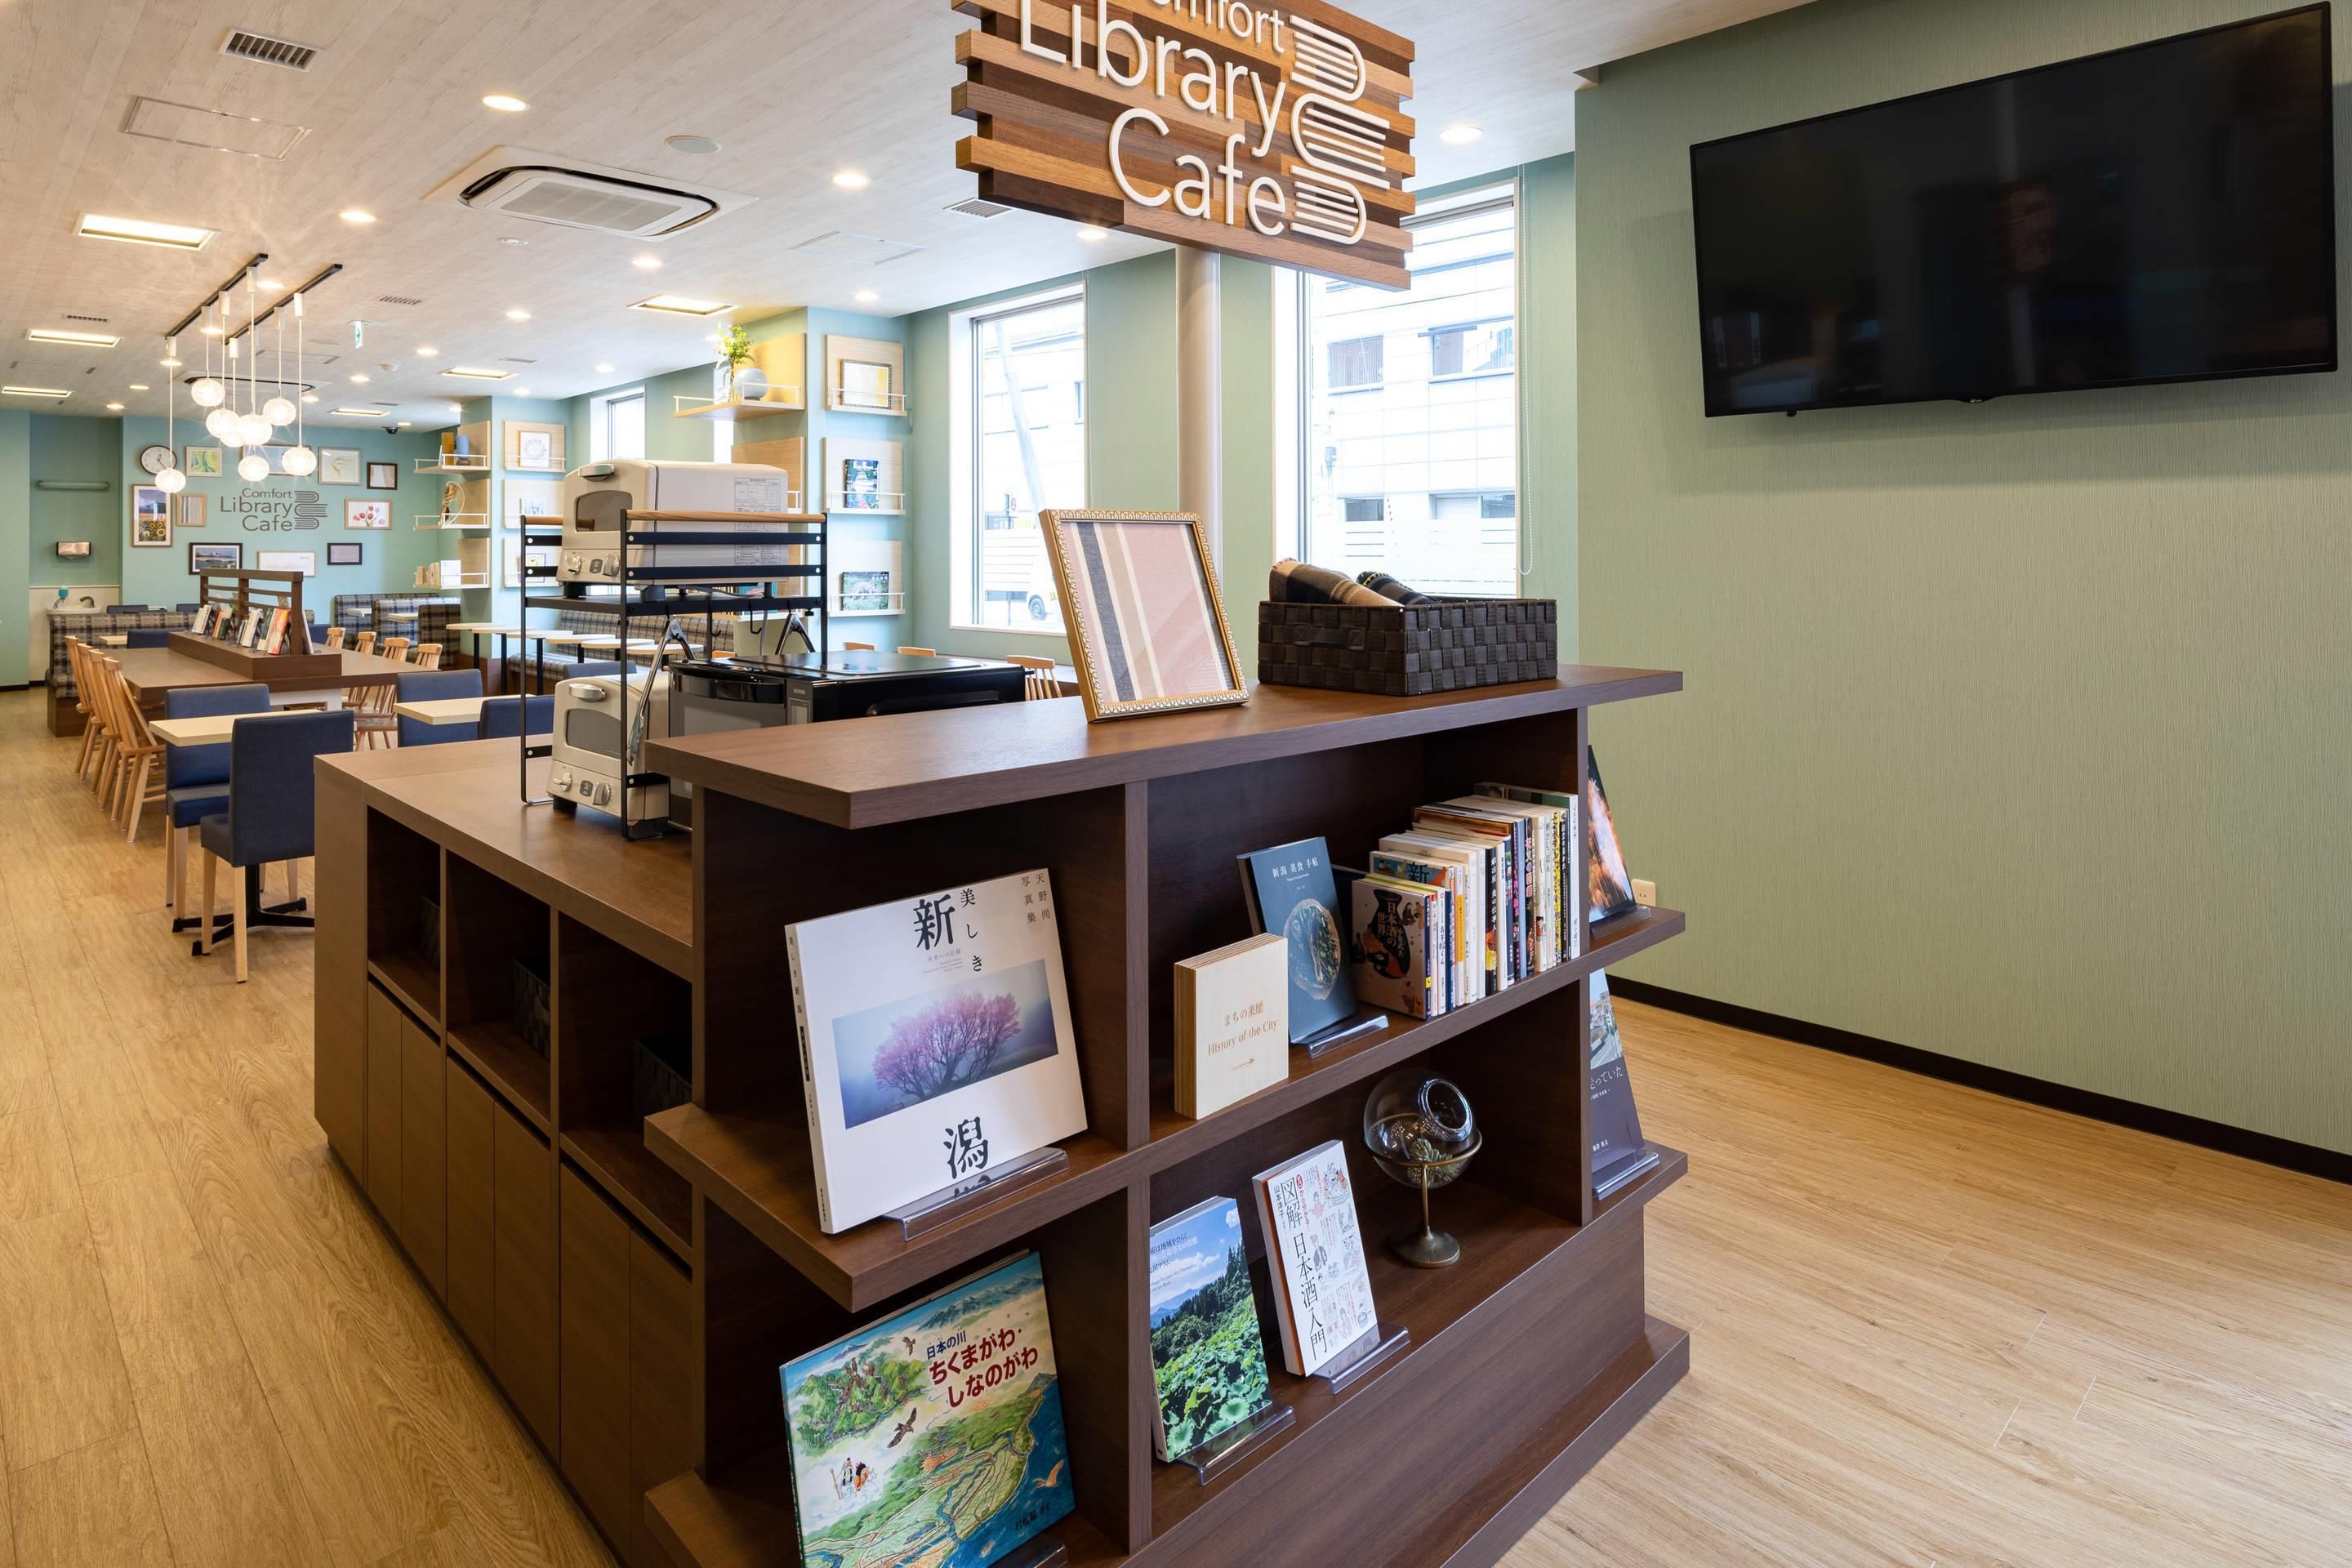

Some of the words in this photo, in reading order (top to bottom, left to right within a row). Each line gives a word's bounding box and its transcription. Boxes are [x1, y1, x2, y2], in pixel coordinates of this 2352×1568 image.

[1020, 0, 1286, 158] Library
[1108, 108, 1286, 236] Cafe
[220, 496, 293, 519] Library
[242, 488, 293, 499] Comfort
[242, 514, 293, 532] Cafe
[912, 893, 956, 951] 新
[1021, 875, 1037, 924] 写真集
[1036, 872, 1051, 922] 天野尚
[960, 888, 982, 972] 美しき
[1208, 1036, 1236, 1056] History
[1238, 1029, 1248, 1043] of
[1249, 1026, 1261, 1039] the
[1263, 1019, 1278, 1032] City
[942, 1116, 989, 1179] 潟
[1280, 1177, 1303, 1229] 図解
[1293, 1232, 1328, 1361] 日本酒入門
[926, 1330, 967, 1361] 日本の川
[947, 1346, 1039, 1408] しなのがわ
